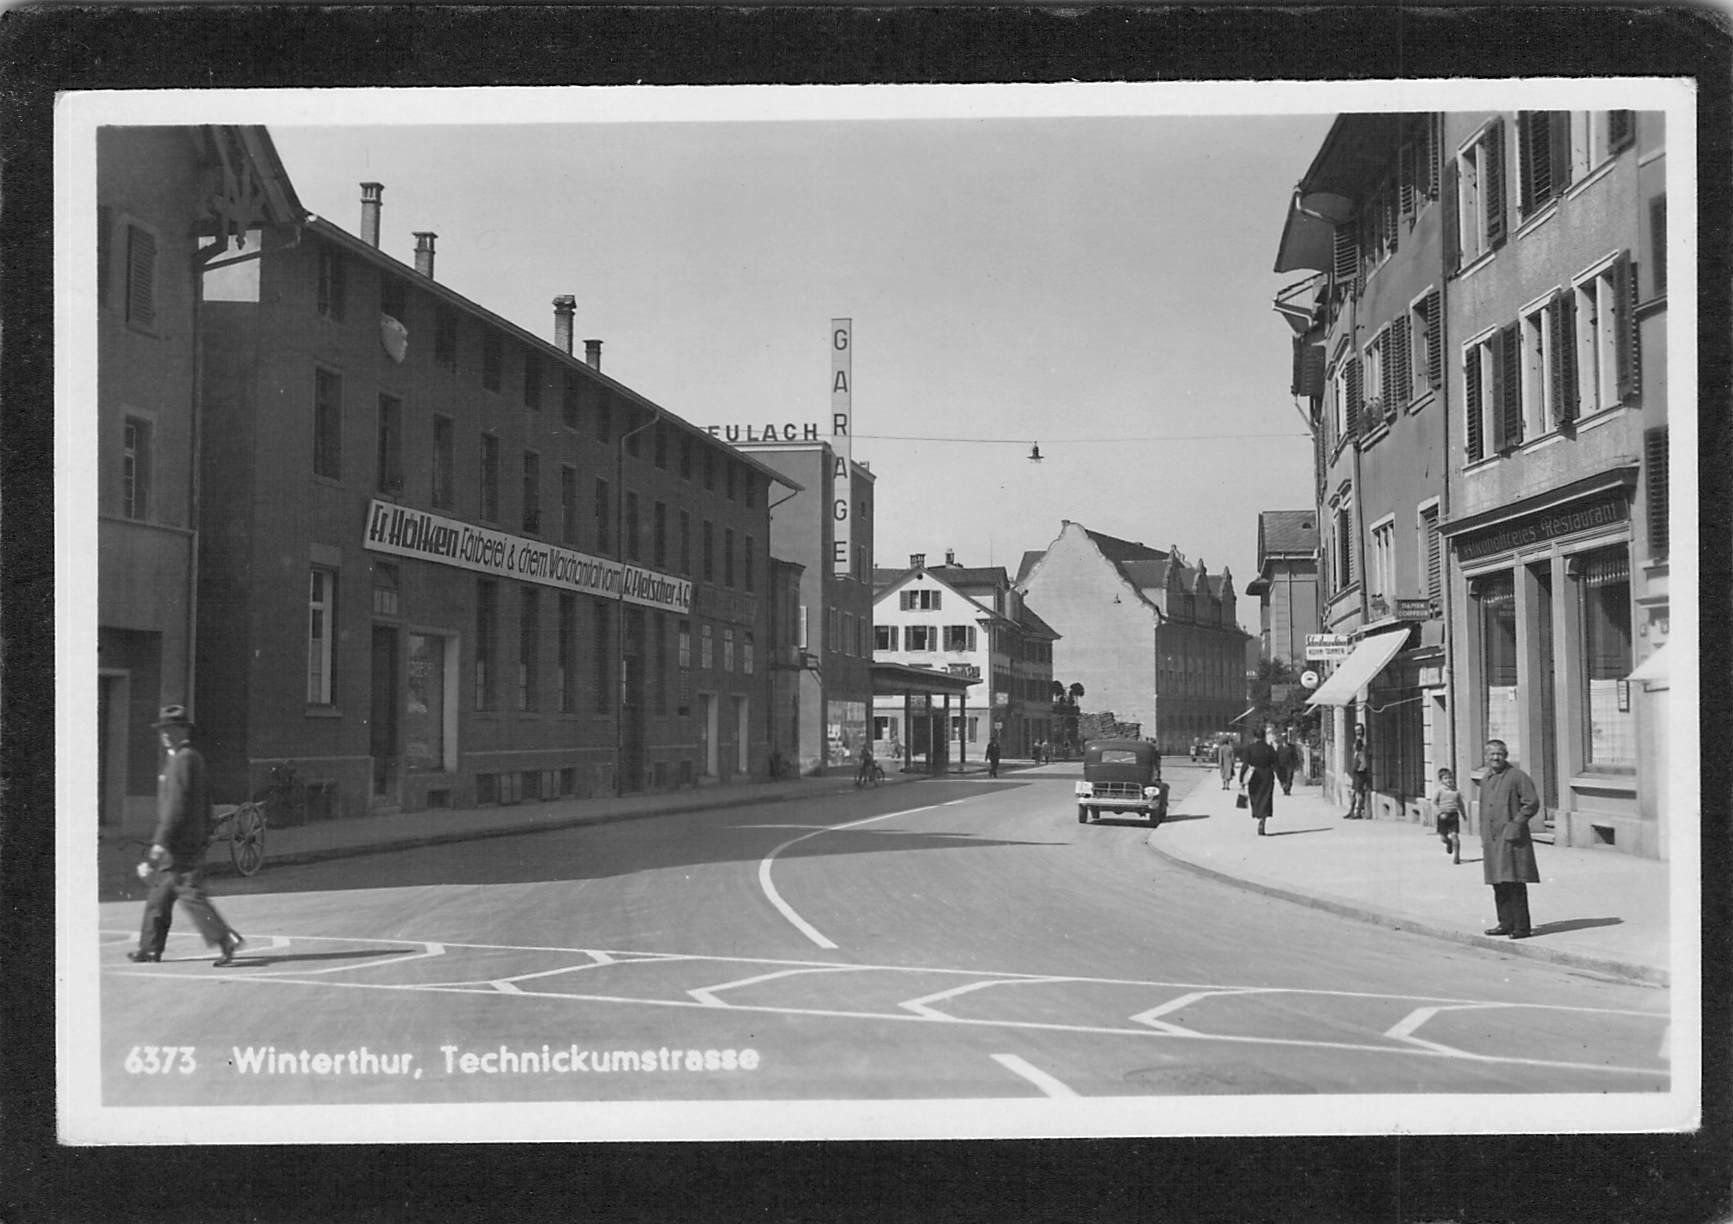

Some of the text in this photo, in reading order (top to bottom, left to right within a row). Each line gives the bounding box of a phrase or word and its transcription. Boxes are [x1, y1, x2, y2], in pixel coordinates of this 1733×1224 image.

[832, 328, 849, 563] GARAGE
[1540, 503, 1617, 537] Restaurant
[459, 526, 508, 569] Färberei
[507, 543, 516, 570] &
